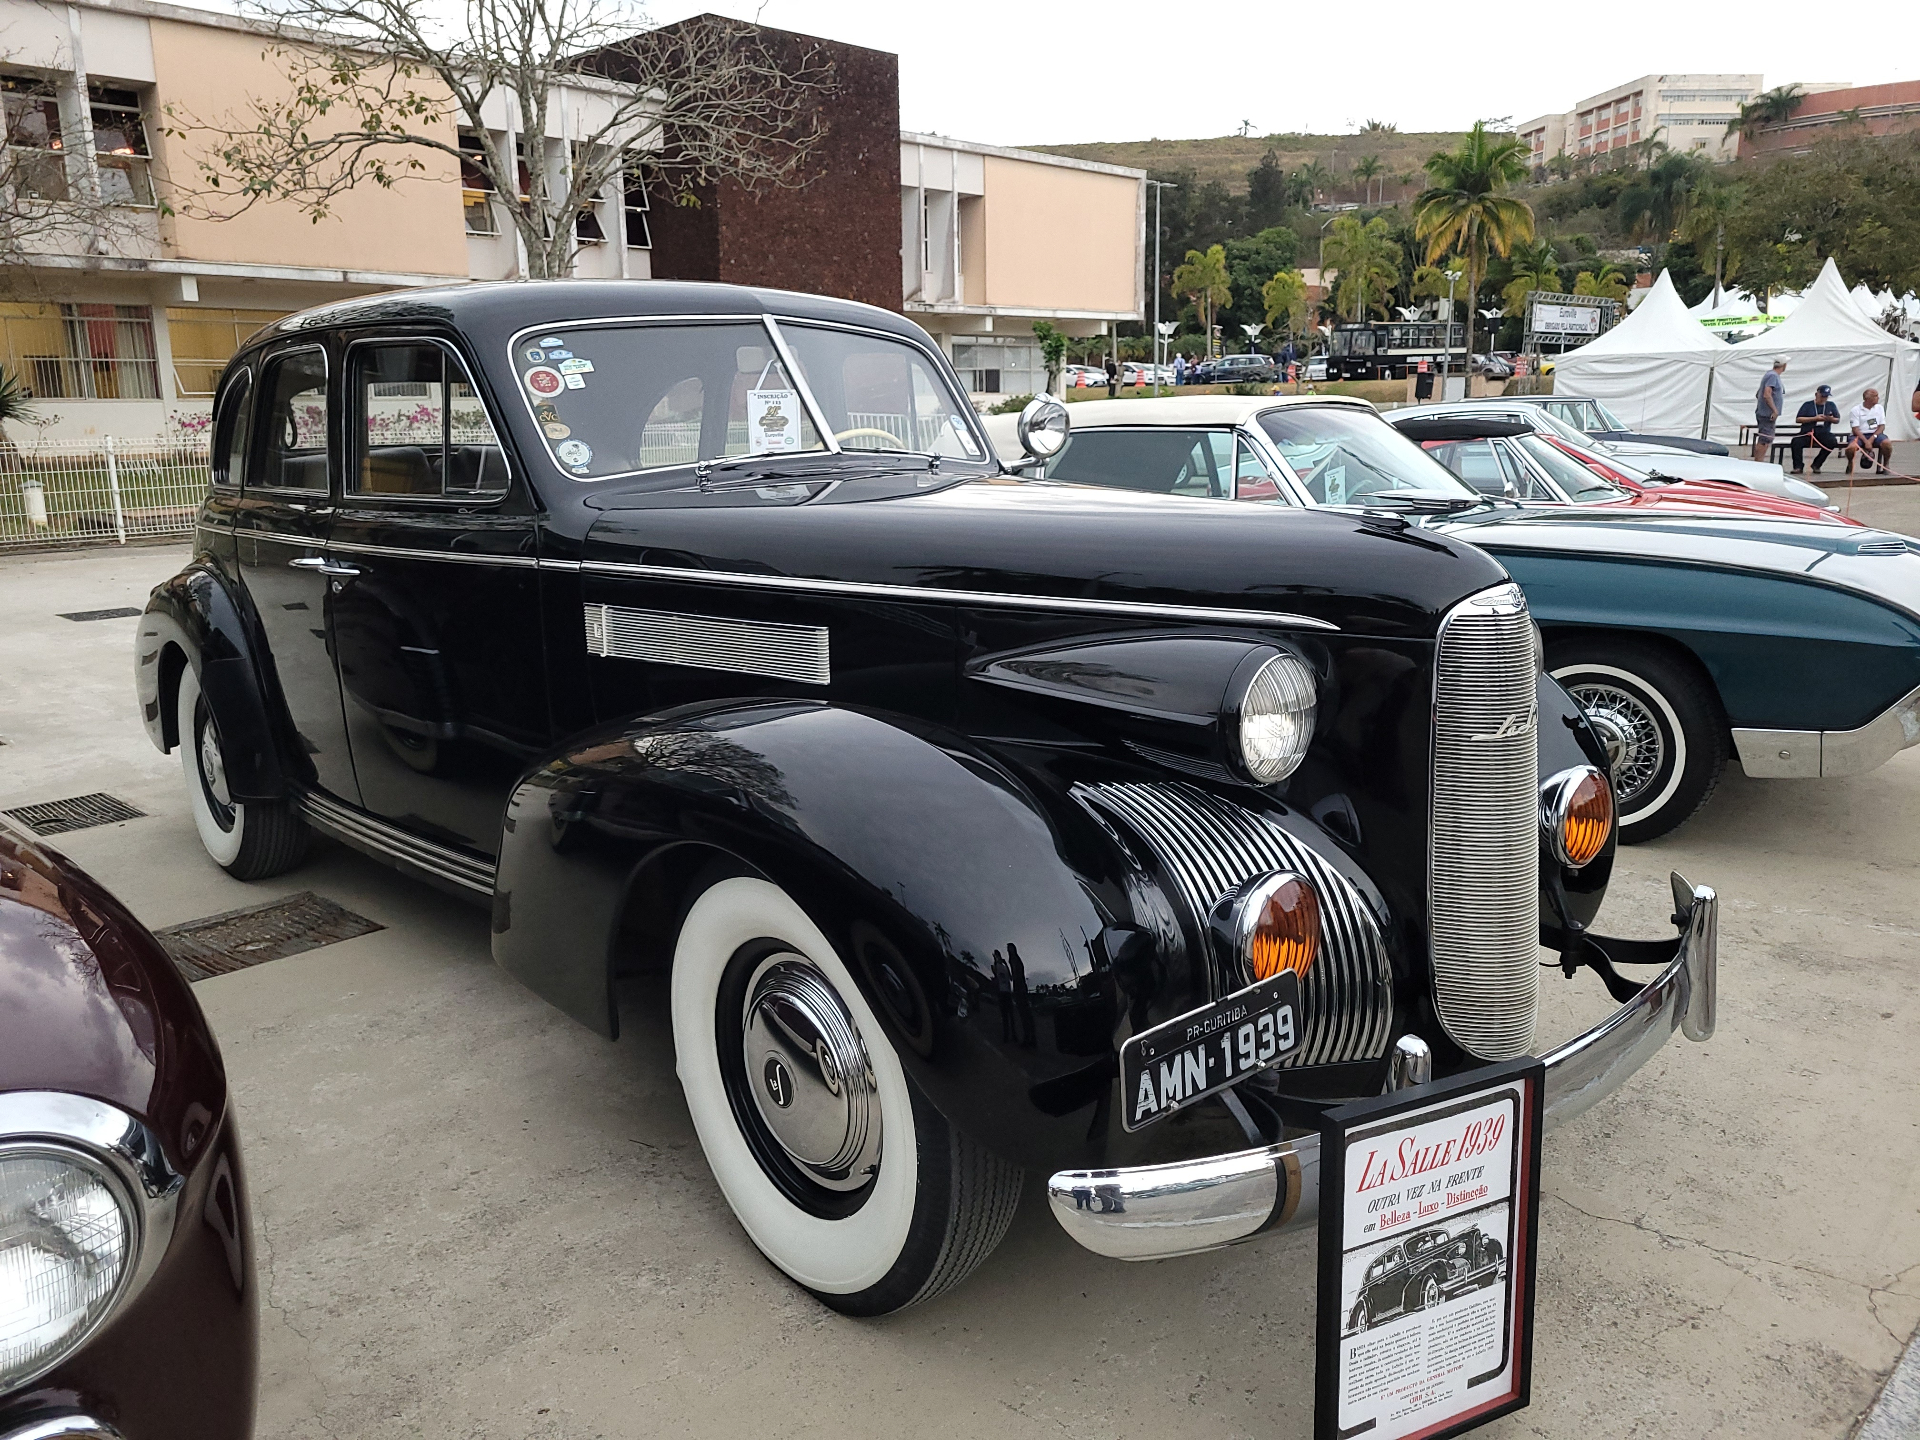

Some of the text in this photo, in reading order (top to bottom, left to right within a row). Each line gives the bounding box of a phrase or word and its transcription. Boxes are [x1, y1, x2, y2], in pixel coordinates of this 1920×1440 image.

[1186, 1004, 1248, 1041] PR-CURITIBA
[1454, 1113, 1505, 1163] 1939
[1367, 1165, 1485, 1214] OUTRA VEZ NA FRENTE
[1363, 1222, 1376, 1233] em
[1379, 1210, 1411, 1229] Belleza
[1418, 1200, 1439, 1216] Luxo
